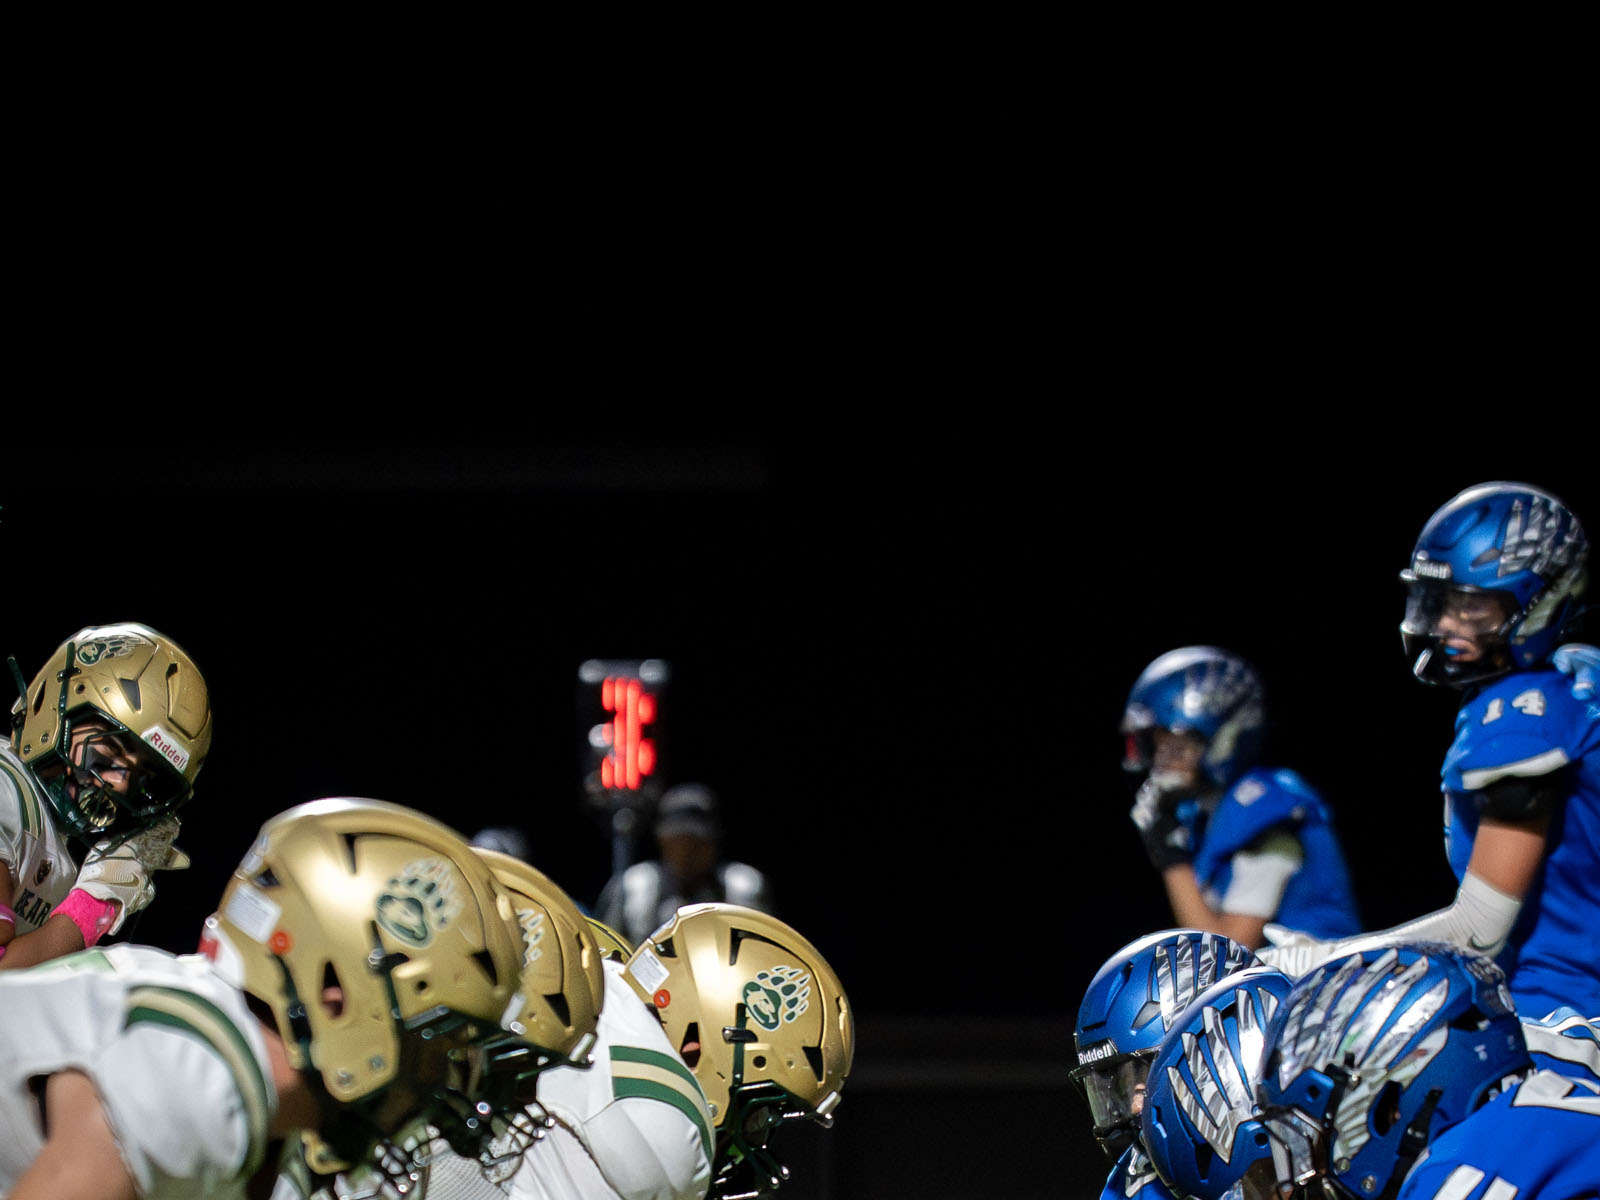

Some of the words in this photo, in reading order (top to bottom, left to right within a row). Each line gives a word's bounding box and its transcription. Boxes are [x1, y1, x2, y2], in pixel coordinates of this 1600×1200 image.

[1482, 688, 1547, 726] 14
[150, 731, 187, 769] Riddell
[1078, 1043, 1112, 1066] Riddell
